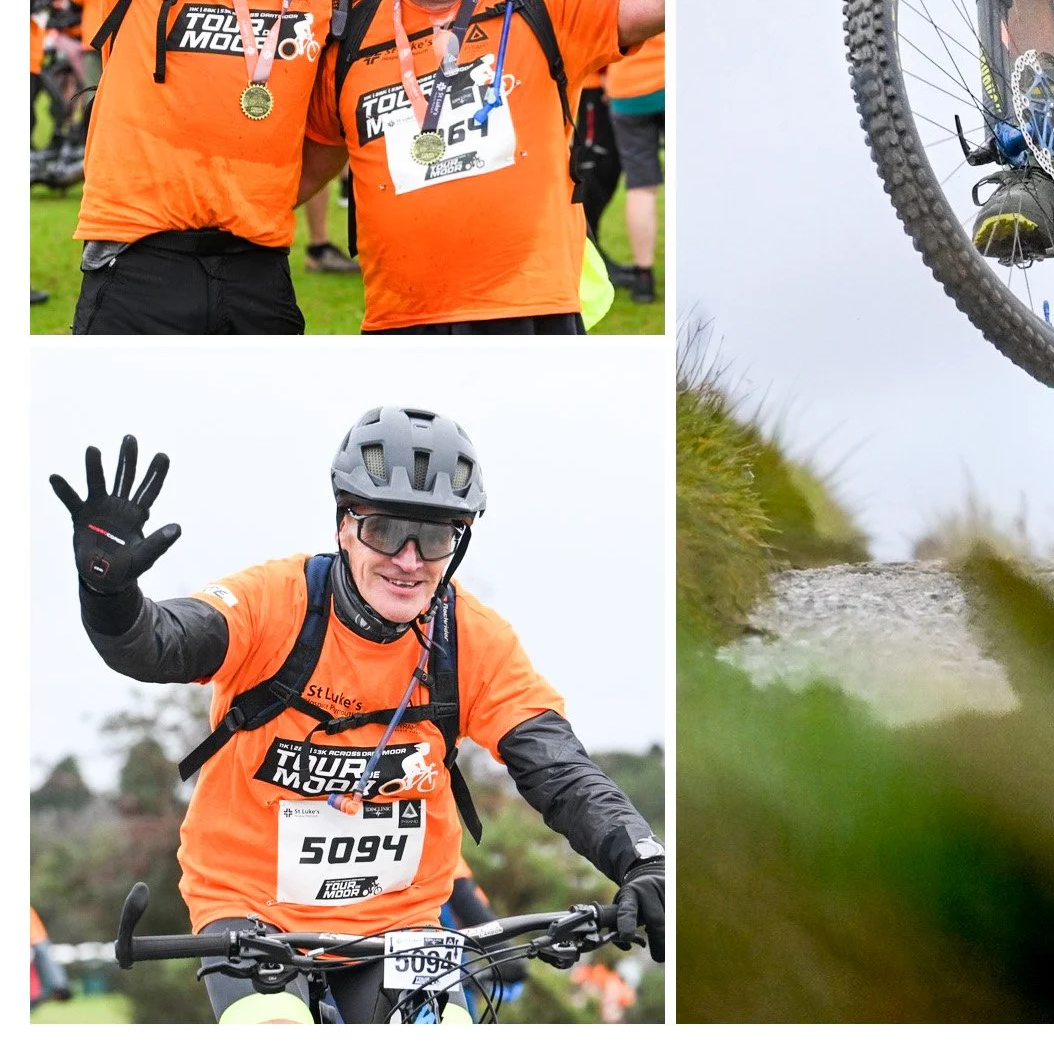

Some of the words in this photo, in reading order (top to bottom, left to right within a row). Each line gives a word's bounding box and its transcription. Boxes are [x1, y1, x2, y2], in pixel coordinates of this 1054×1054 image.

[307, 684, 324, 699] St
[324, 687, 363, 711] Luke's
[328, 749, 362, 757] ACROSS
[272, 767, 376, 796] MOOR
[299, 834, 408, 865] 5094
[323, 888, 359, 898] MOOR
[325, 882, 356, 891] TOUR
[394, 950, 455, 974] 5094
